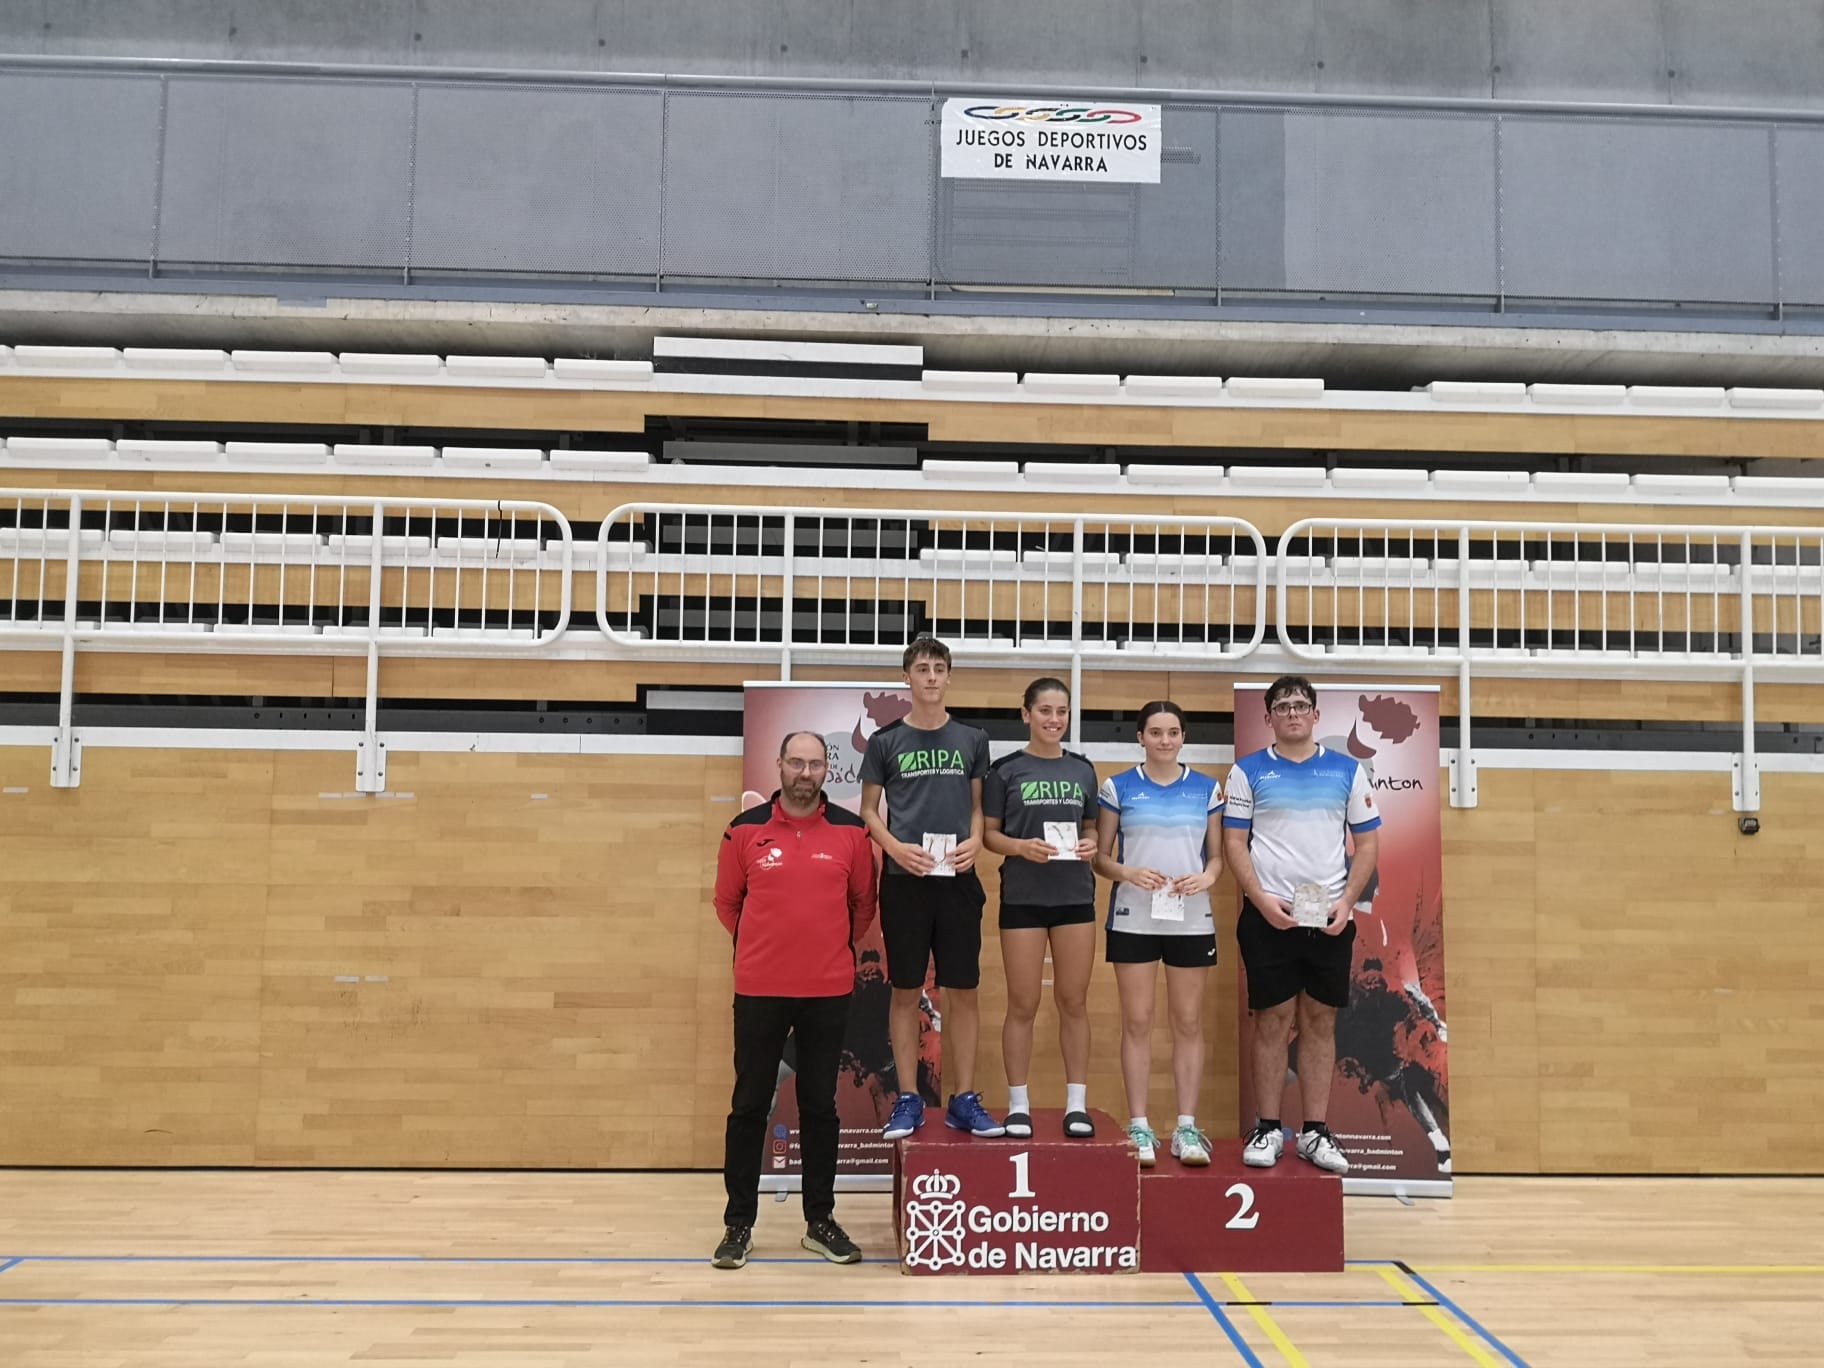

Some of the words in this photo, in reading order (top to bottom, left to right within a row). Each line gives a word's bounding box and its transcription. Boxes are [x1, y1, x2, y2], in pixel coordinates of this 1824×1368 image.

[956, 129, 1026, 147] JUEGOS
[1038, 131, 1147, 151] DEPORTIVOS
[994, 153, 1013, 169] DE
[1026, 154, 1108, 173] NAVARRA
[917, 749, 965, 769] RIPA
[1039, 781, 1084, 799] RIPA
[1008, 1151, 1036, 1198] 1
[1225, 1183, 1260, 1229] 2
[968, 1205, 1110, 1233] Gobierno
[968, 1241, 1007, 1269] de
[1015, 1242, 1137, 1269] Navarra
